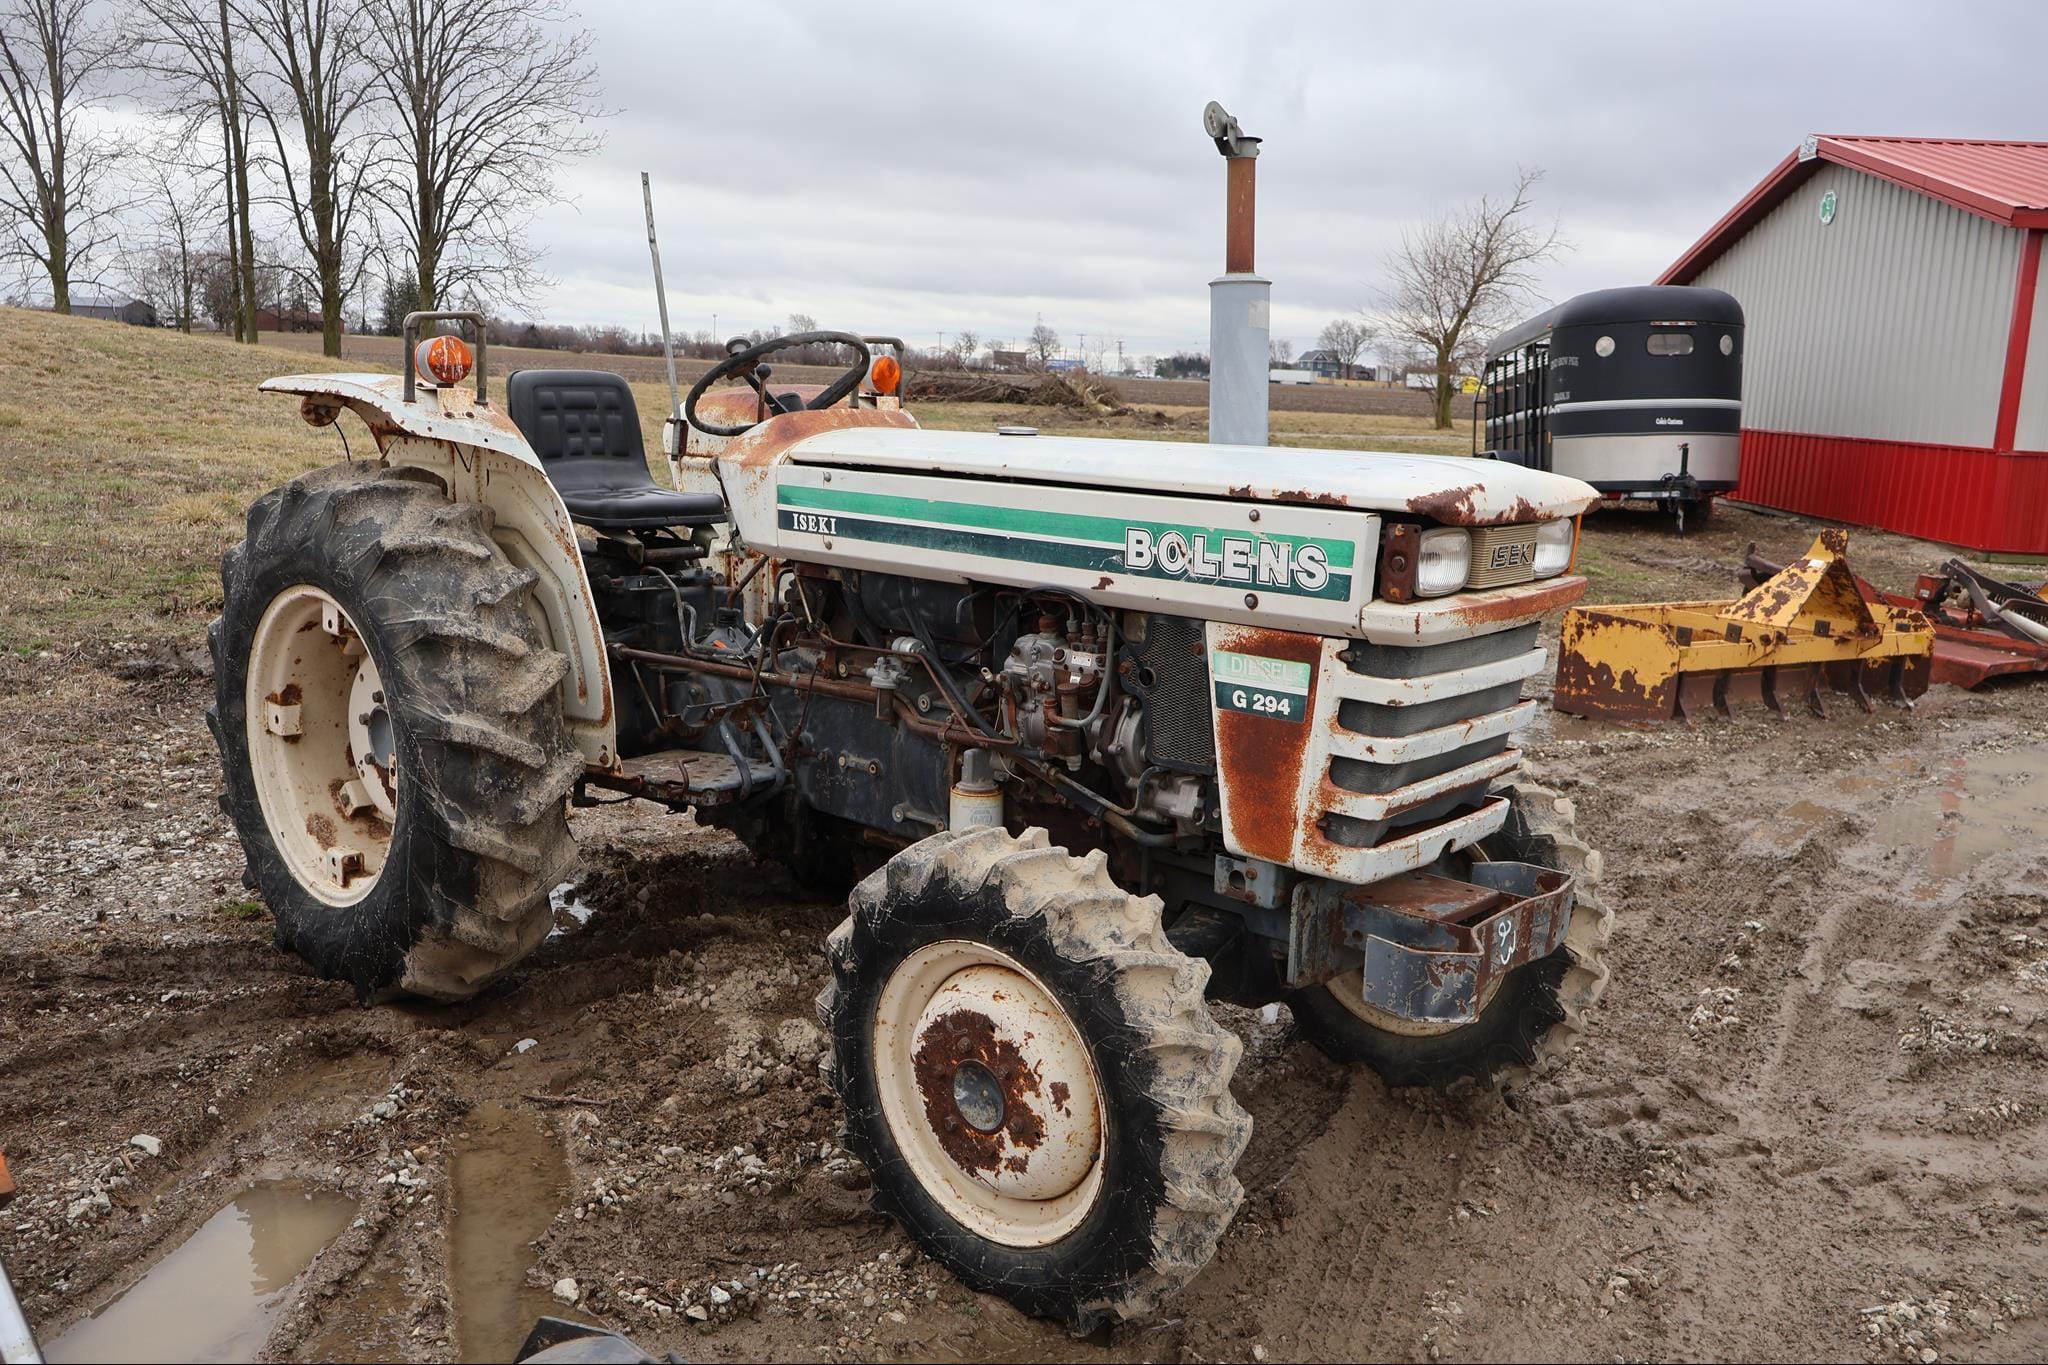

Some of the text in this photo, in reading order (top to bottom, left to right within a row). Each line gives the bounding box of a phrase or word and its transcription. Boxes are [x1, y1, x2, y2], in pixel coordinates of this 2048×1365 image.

[792, 513, 837, 535] ISEKI
[1125, 527, 1329, 591] BOLENS
[1490, 542, 1537, 568] ISEKI
[1232, 690, 1291, 715] G 294
